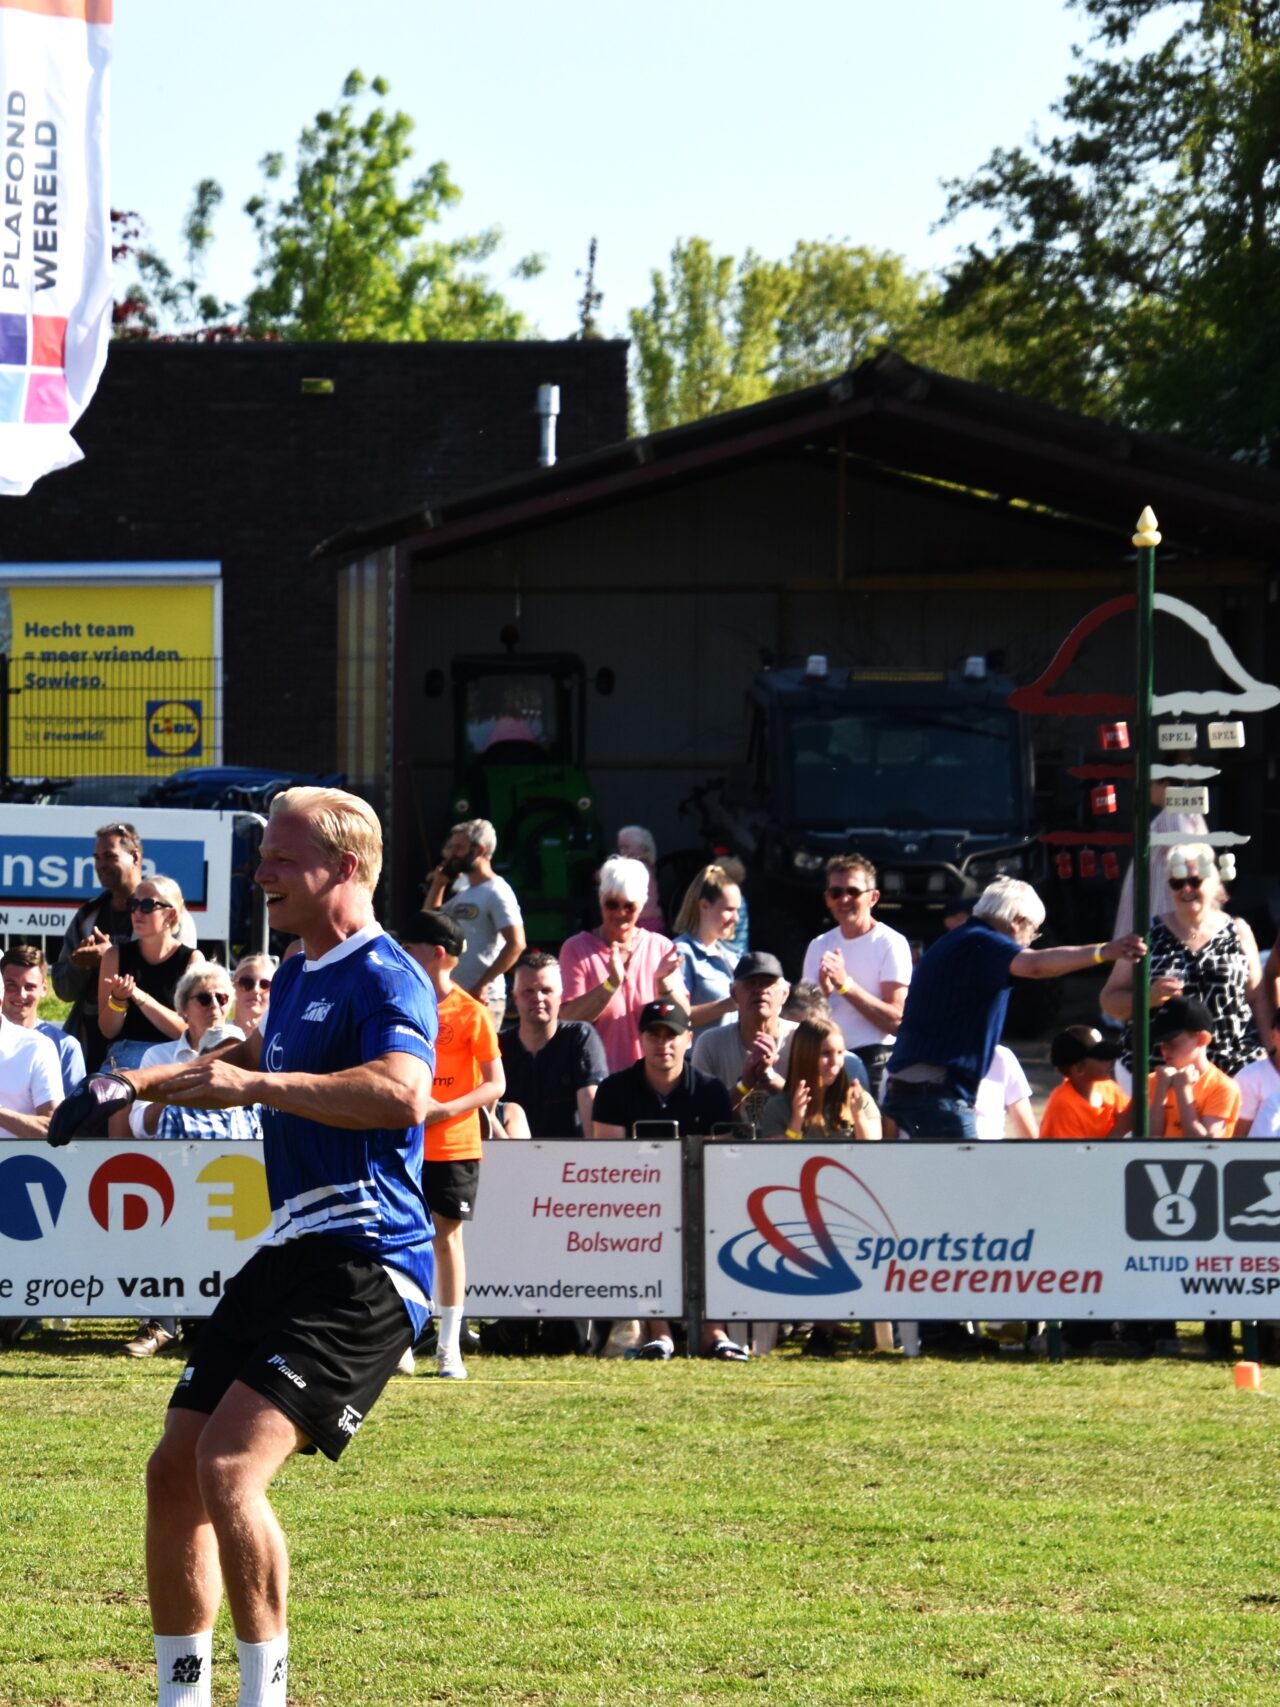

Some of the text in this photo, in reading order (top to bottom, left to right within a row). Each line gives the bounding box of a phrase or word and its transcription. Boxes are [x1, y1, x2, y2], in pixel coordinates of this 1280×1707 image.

[2, 90, 26, 290] PLAFOND
[33, 120, 58, 292] WERELD
[25, 621, 135, 638] Hecht team
[41, 650, 88, 662] meer
[1161, 733, 1192, 742] SPEL
[1211, 731, 1238, 740] SPEL
[27, 913, 67, 927] AUDI
[562, 1162, 661, 1184] Easterein
[532, 1197, 662, 1218] Heerenveen
[566, 1231, 663, 1253] Bolsward
[855, 1228, 1035, 1270] sportstad
[1124, 1255, 1190, 1273] ALTIJD
[1195, 1256, 1235, 1273] HET
[883, 1259, 1103, 1294] heerenveen
[24, 1275, 104, 1306] groep
[117, 1277, 185, 1298] van
